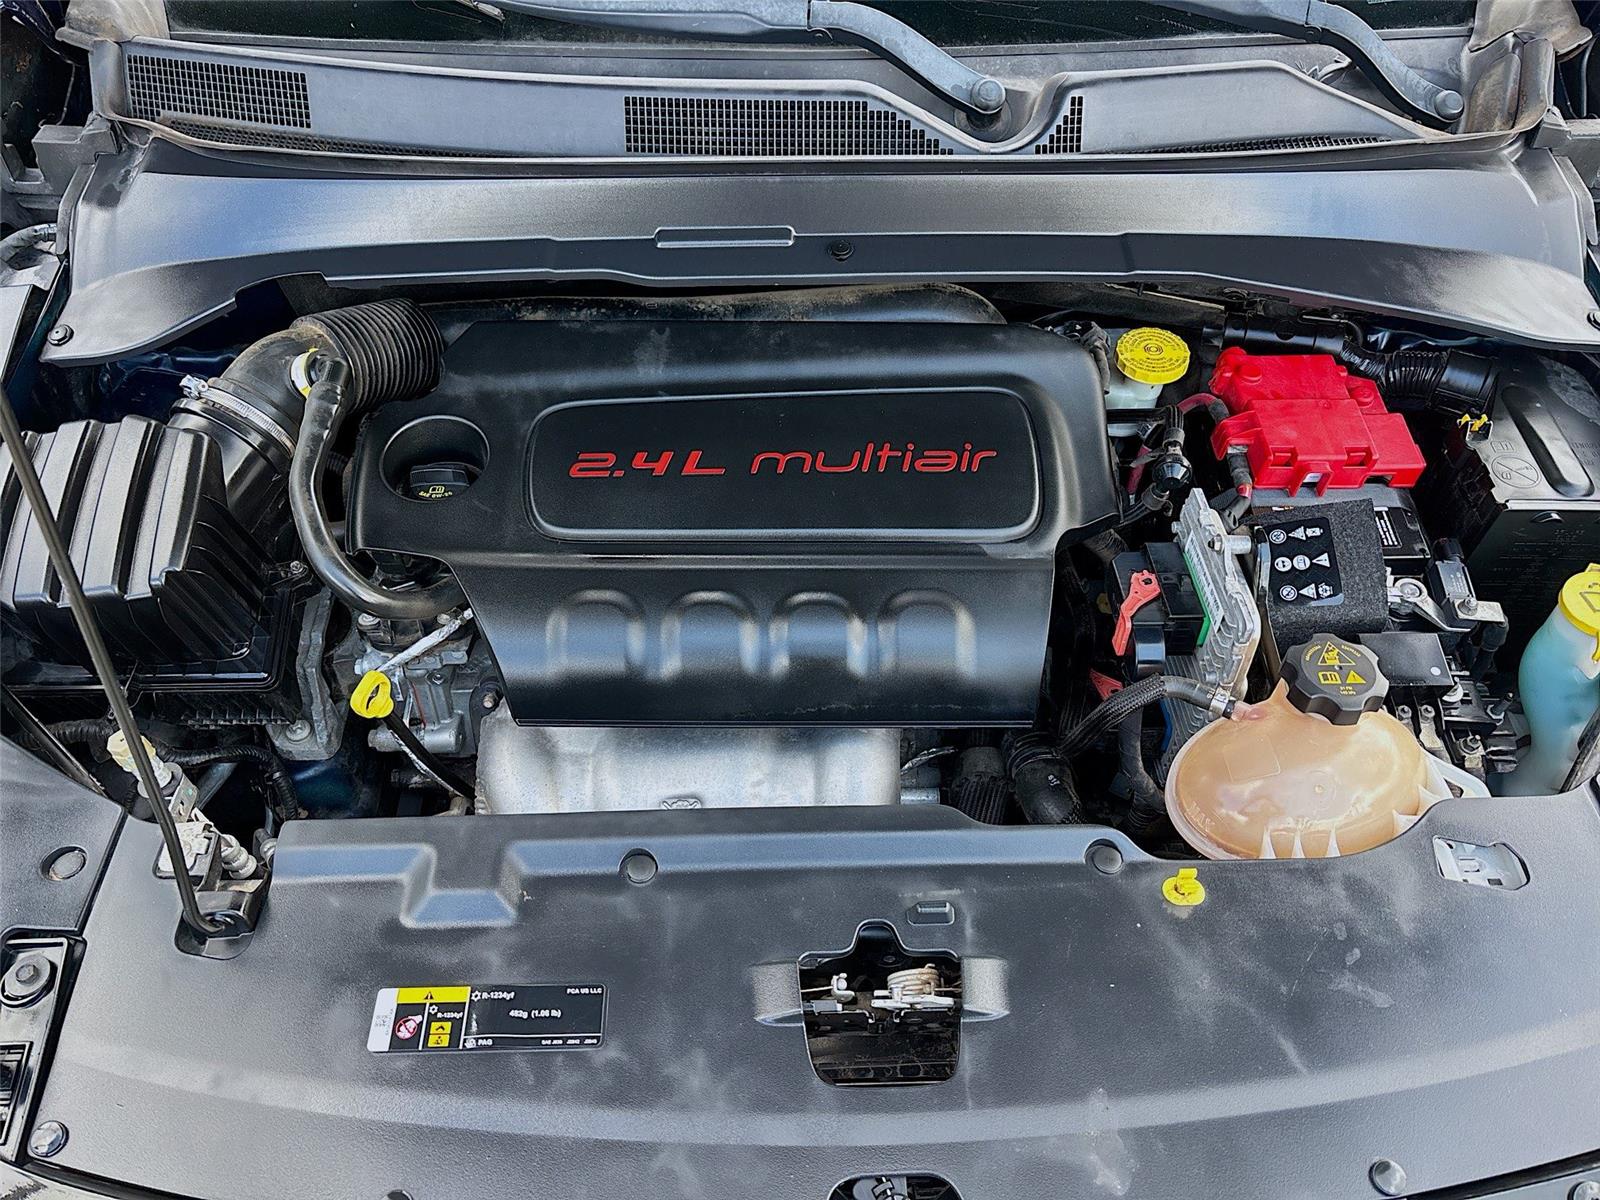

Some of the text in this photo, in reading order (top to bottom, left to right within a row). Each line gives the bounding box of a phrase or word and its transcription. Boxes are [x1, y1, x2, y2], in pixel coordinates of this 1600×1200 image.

[568, 442, 998, 478] 2.4L multiair
[481, 991, 515, 1001] R-1234yf
